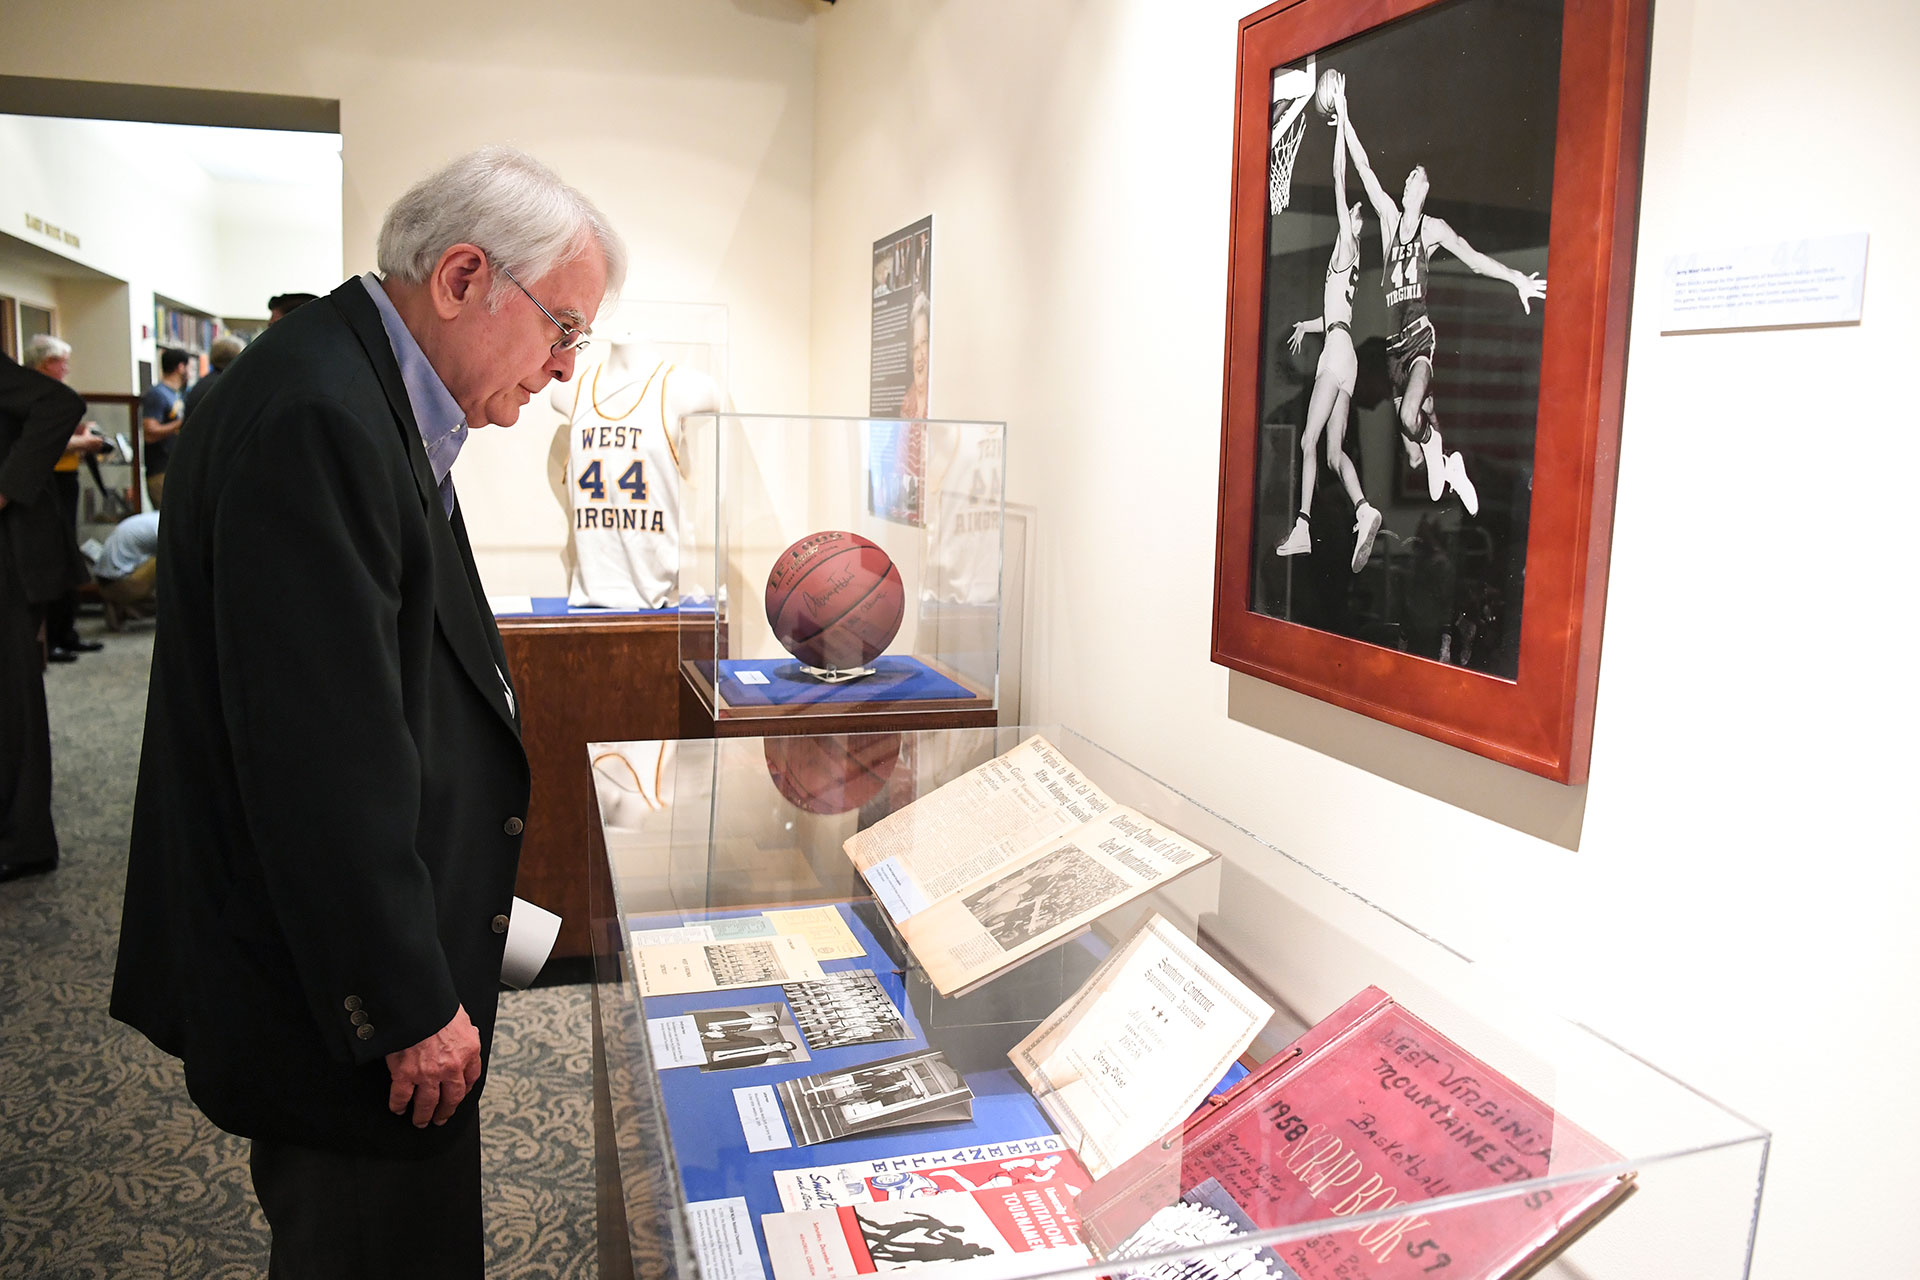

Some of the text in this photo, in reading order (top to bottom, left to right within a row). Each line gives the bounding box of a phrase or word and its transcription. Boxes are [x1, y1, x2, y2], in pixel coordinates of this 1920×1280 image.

[1391, 242, 1420, 261] WEST
[1391, 257, 1418, 288] 44
[1385, 283, 1422, 308] VIRGINIA
[582, 426, 642, 450] WEST
[577, 459, 649, 503] 44
[577, 507, 665, 532] IRGINIA
[998, 755, 1026, 782] Team Given
[1030, 739, 1110, 813] West Virginia to Meet Cal Tonight
[1034, 769, 1050, 783] After
[1046, 781, 1072, 806] Walloping
[1066, 800, 1093, 823] Louisvill
[1109, 814, 1142, 837] Cheering
[1134, 828, 1167, 848] Crowd
[1162, 846, 1195, 865] 6,000
[1098, 837, 1162, 880] Greet Mountaineers
[1157, 956, 1215, 1013] Southern Conference
[1092, 1049, 1112, 1076] Jerry
[1263, 1100, 1308, 1142] 1958
[872, 1138, 1059, 1174] GREENVILLE
[809, 1173, 837, 1201] Smith
[1276, 1123, 1431, 1264] SCRAP BOOK
[1044, 1187, 1067, 1215] University
[1061, 1215, 1076, 1224] of
[1406, 1239, 1451, 1274] 59
